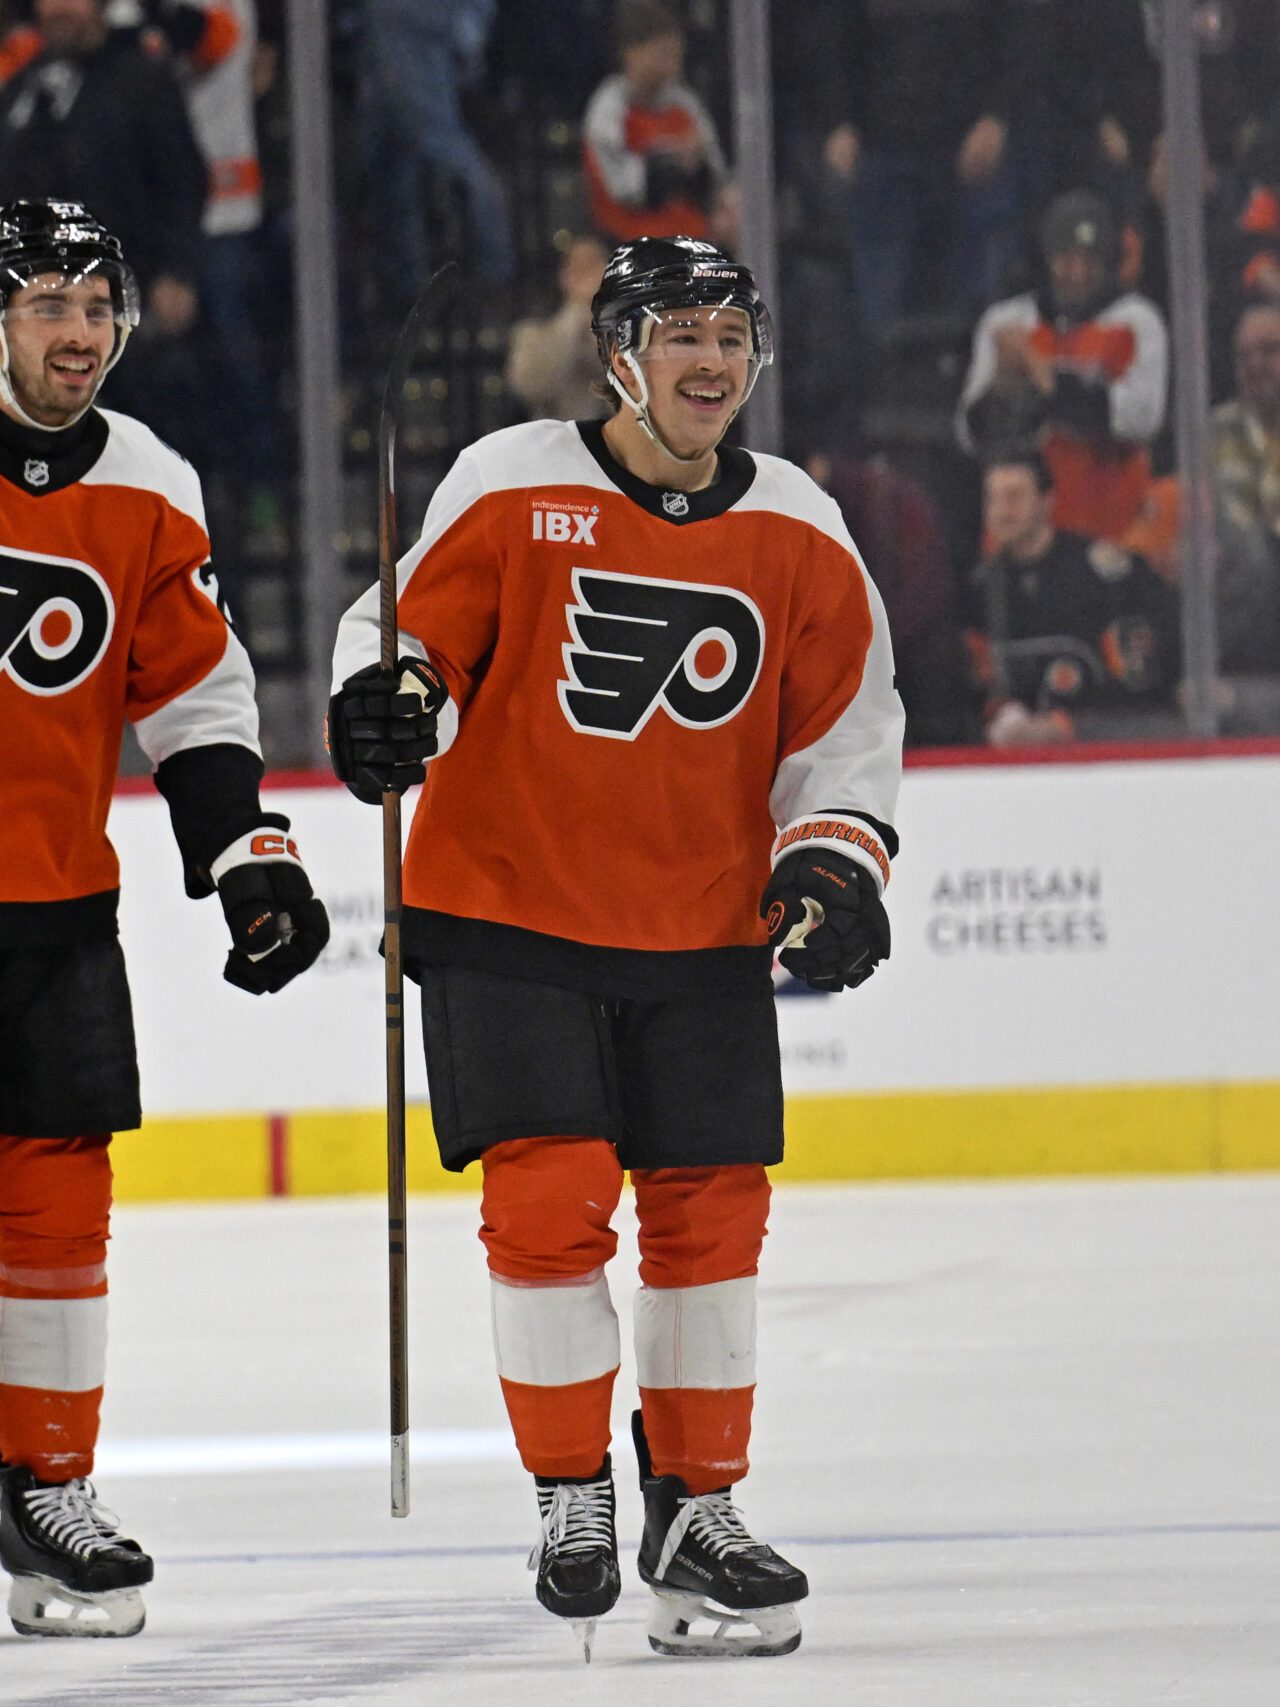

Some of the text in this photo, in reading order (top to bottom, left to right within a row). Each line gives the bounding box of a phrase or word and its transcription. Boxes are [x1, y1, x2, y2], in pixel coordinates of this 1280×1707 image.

[692, 269, 738, 280] BAUER
[532, 501, 590, 513] Independence
[532, 510, 598, 546] IBX
[930, 867, 1102, 905] ARTISAN
[926, 911, 1108, 954] CHEESES
[676, 1553, 714, 1580] BAUER
